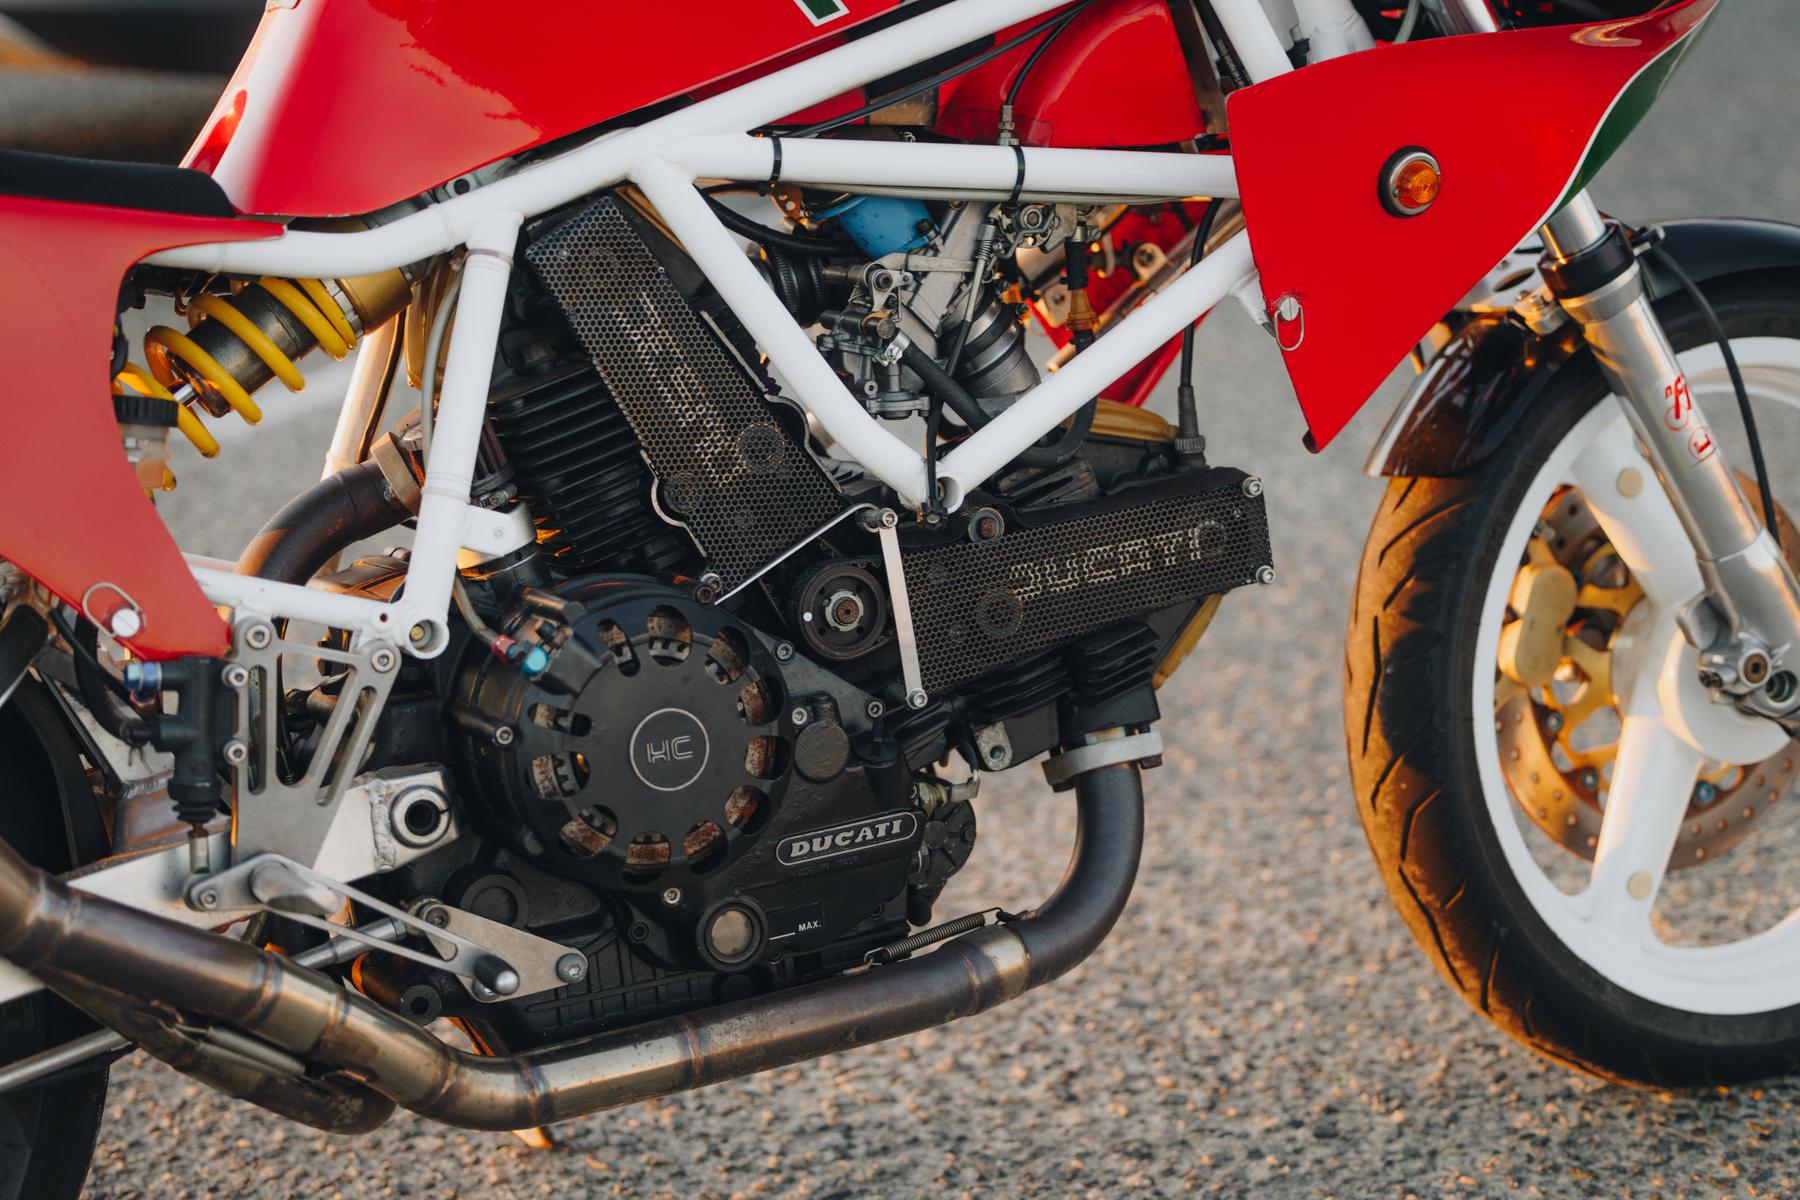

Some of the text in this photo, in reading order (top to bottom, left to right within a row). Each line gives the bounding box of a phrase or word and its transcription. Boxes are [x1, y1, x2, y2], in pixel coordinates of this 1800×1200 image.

[1009, 527, 1201, 602] DUCATI
[646, 735, 694, 764] HC
[789, 819, 903, 858] DUCATI
[797, 920, 822, 932] MAX.
